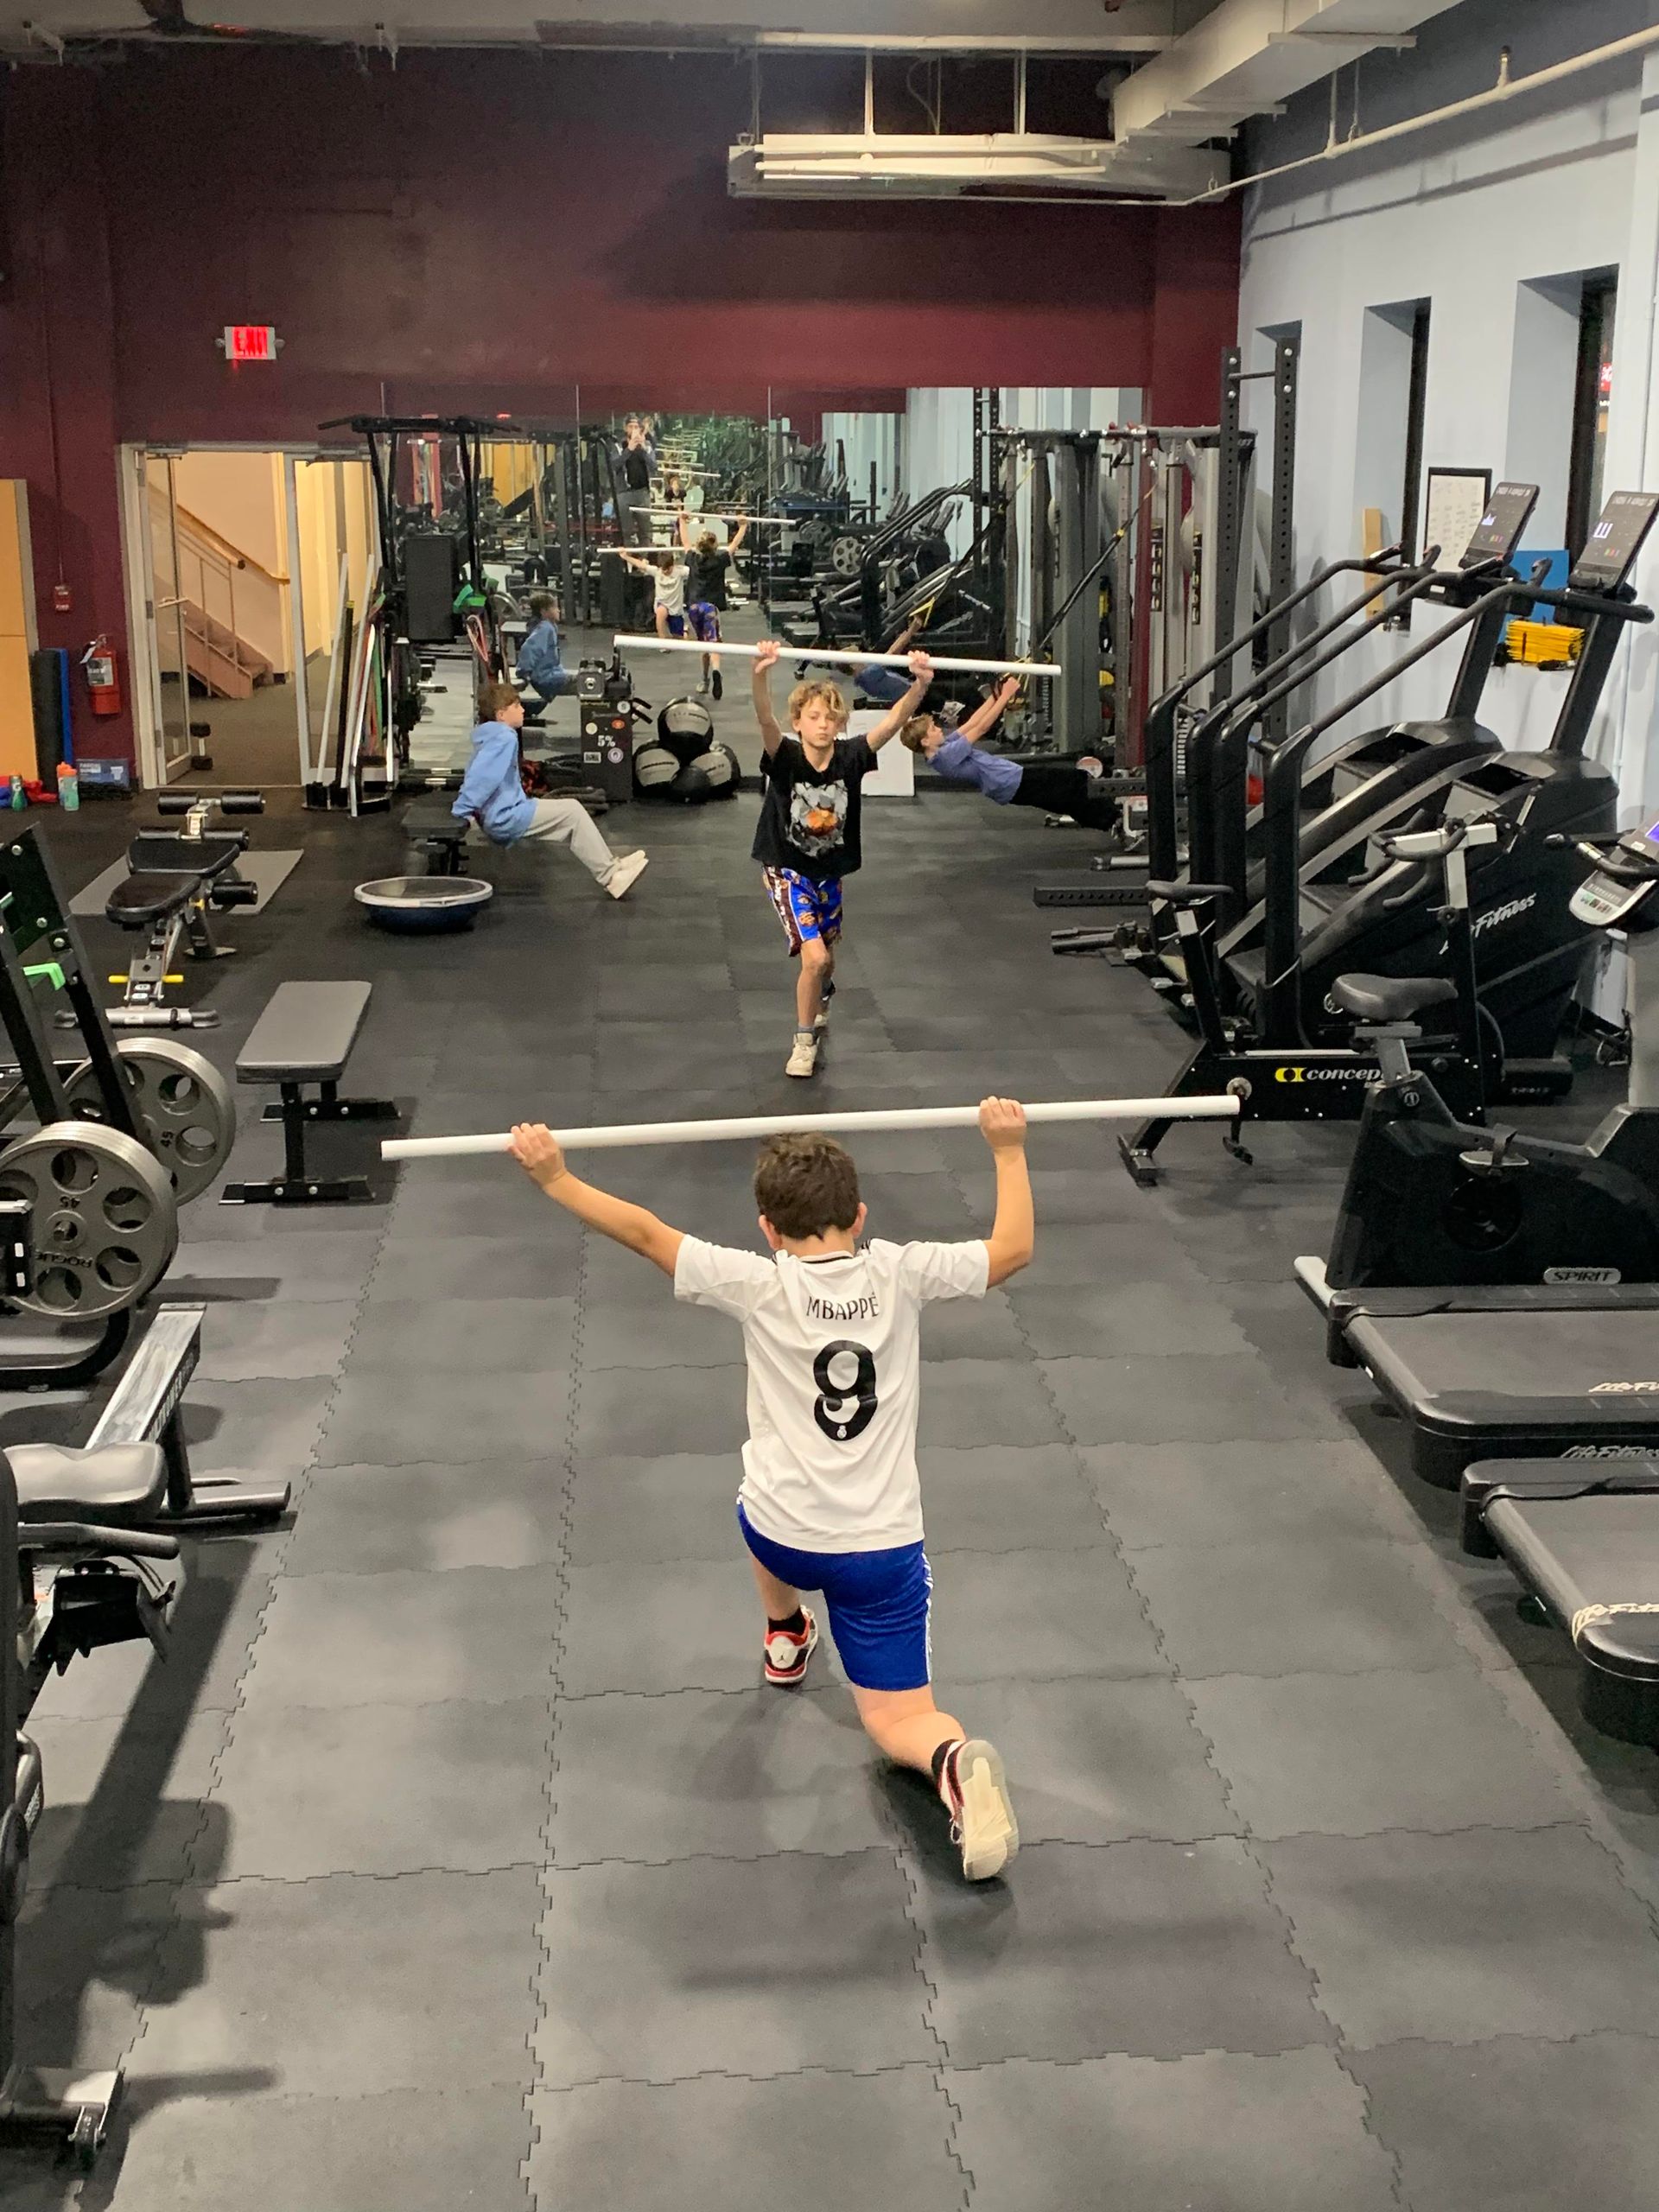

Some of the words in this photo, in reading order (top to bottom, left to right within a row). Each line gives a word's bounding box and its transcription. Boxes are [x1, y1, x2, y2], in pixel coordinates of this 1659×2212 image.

[598, 734, 616, 747] 5%
[1306, 1068, 1383, 1081] concep
[59, 1195, 81, 1210] 45
[1553, 1271, 1613, 1281] SPIRIT
[806, 1292, 880, 1320] MBAPPÉ
[813, 1339, 878, 1441] 9
